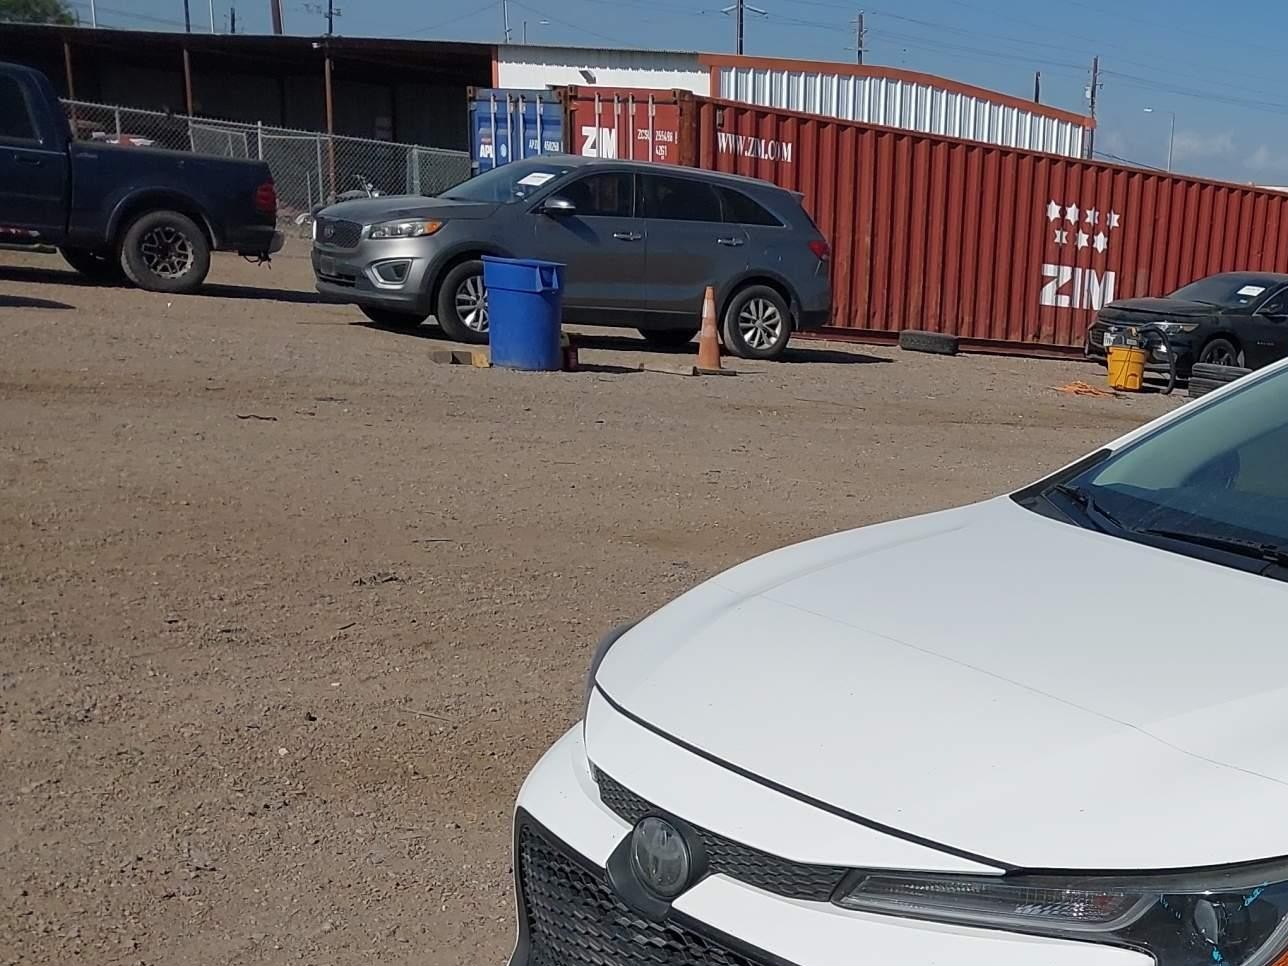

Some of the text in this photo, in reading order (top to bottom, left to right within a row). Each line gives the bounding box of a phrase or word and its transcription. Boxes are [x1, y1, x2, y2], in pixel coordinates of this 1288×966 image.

[582, 126, 616, 159] ZIM
[717, 131, 793, 162] WWW.ZIM.COM
[1040, 263, 1116, 311] ZIM
